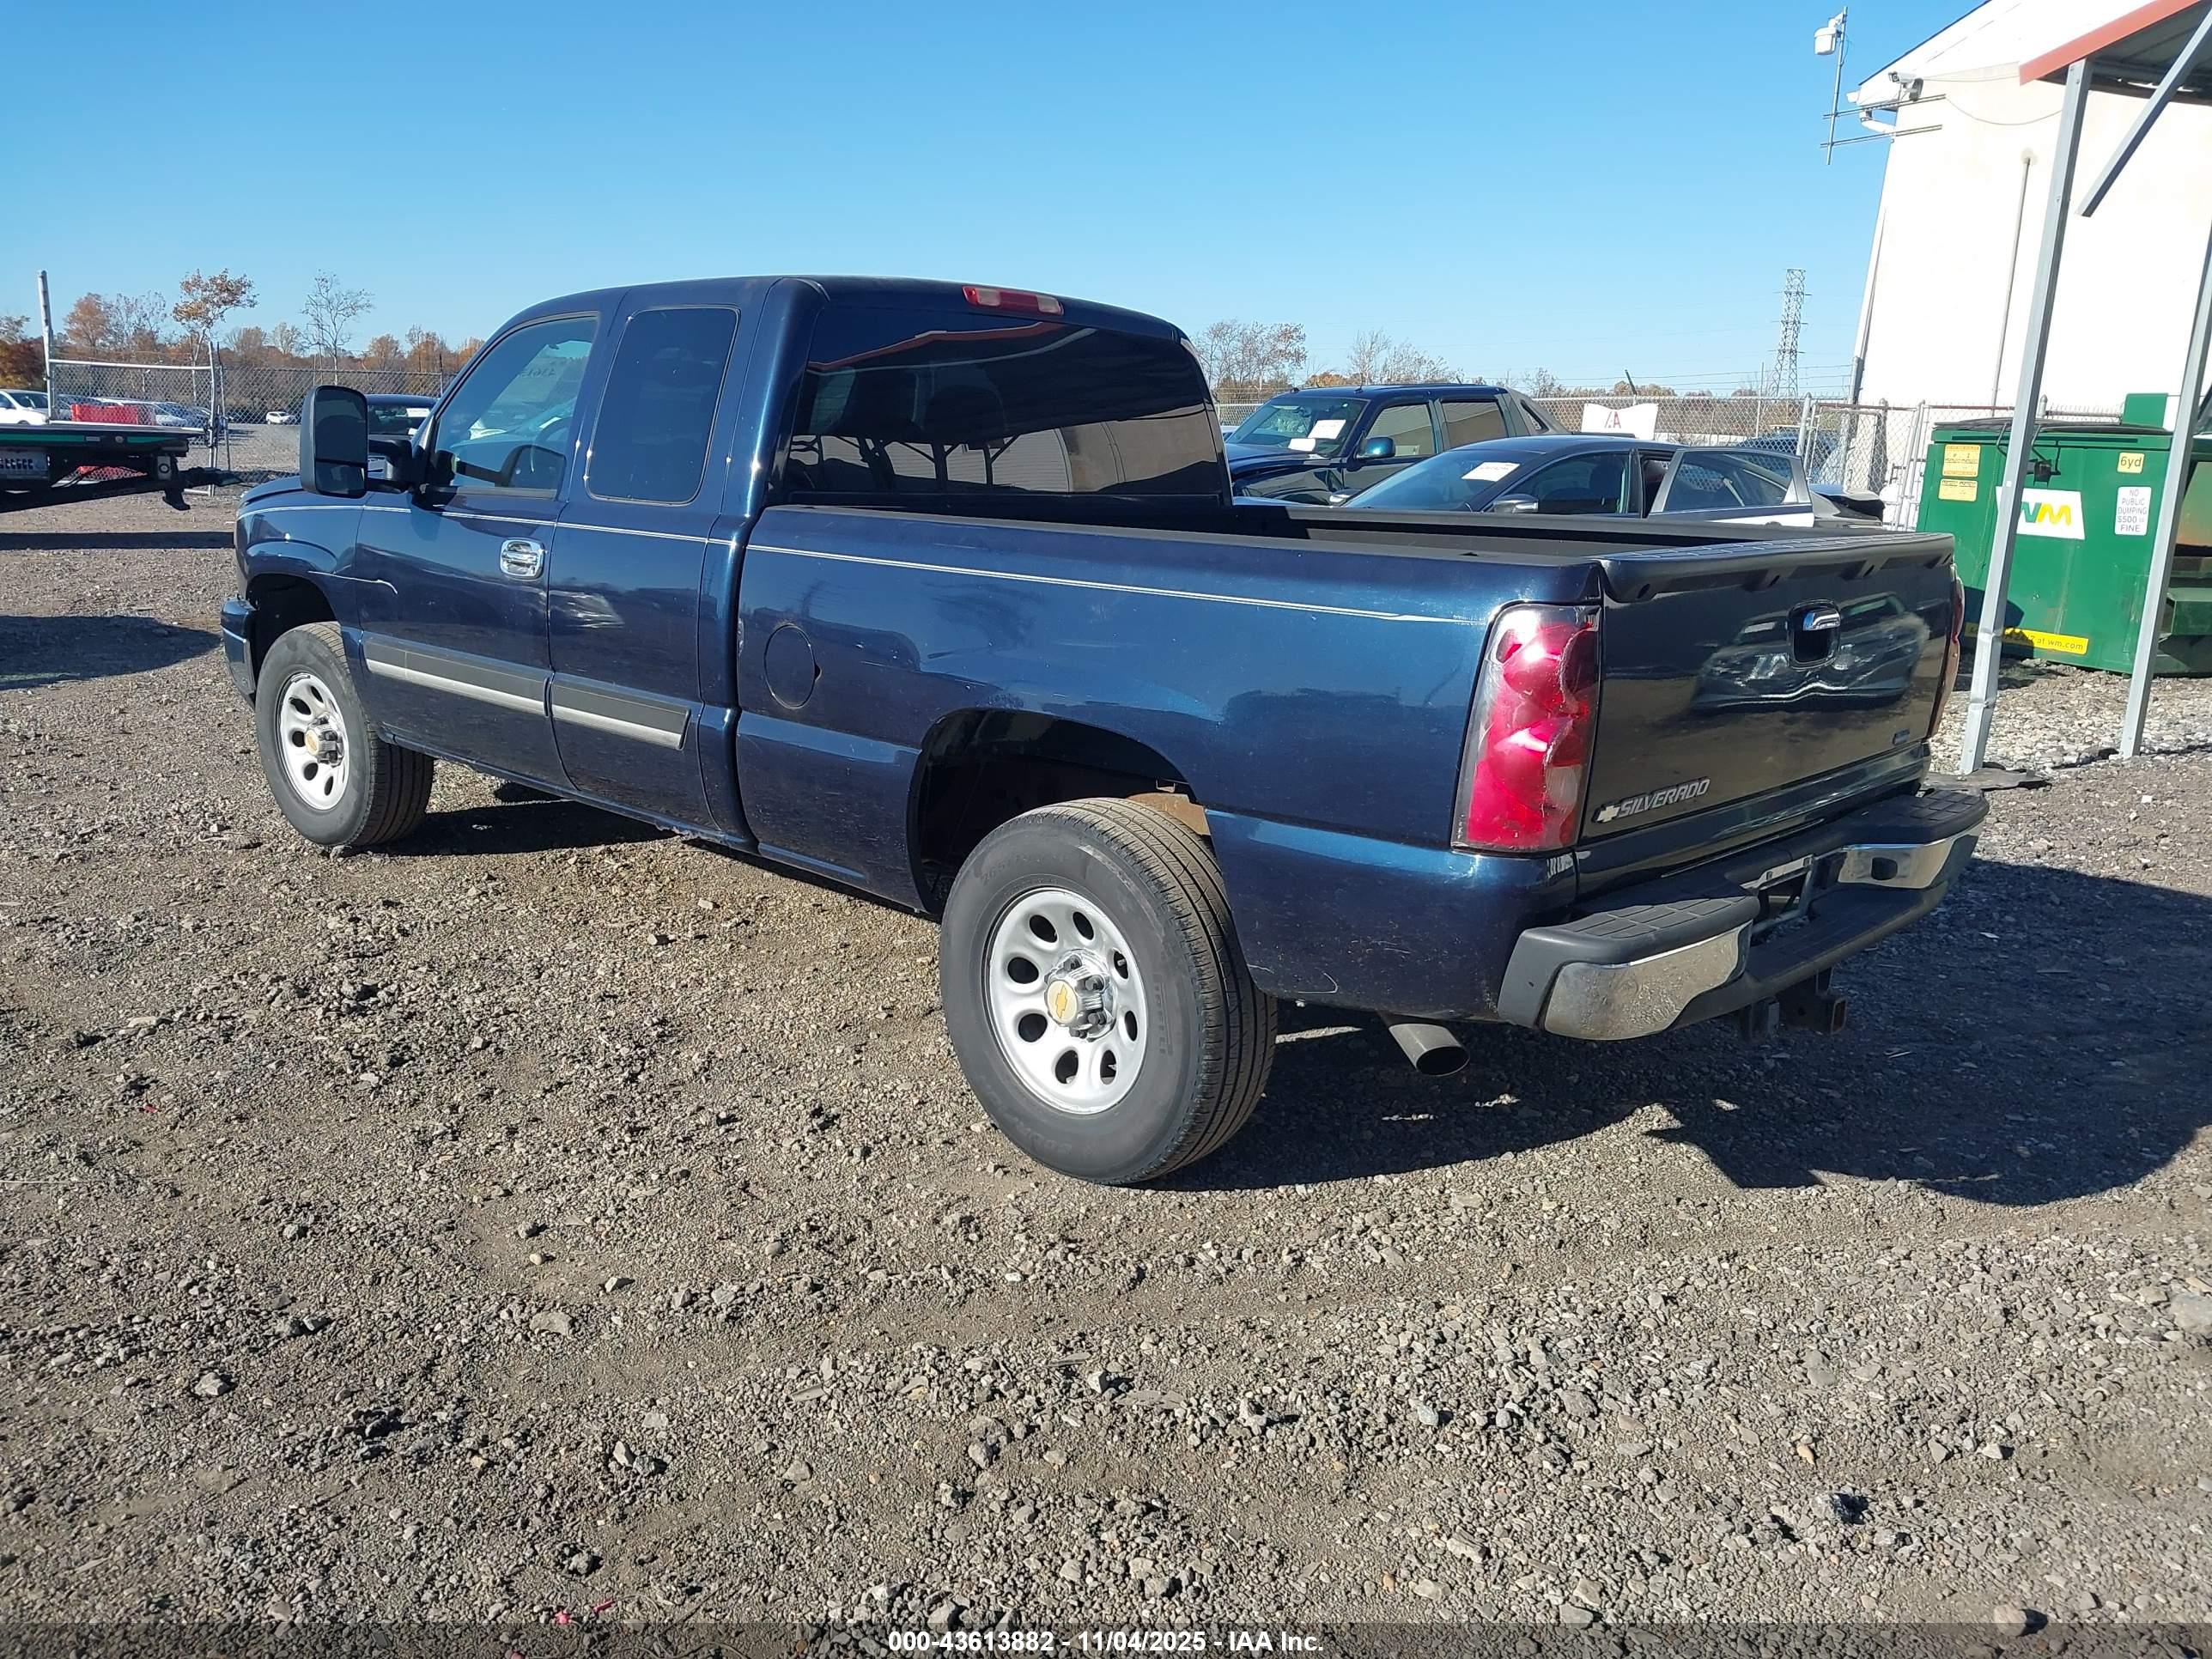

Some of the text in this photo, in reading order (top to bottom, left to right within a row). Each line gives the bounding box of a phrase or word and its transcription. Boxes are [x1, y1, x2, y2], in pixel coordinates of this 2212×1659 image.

[2120, 456, 2142, 469] 6yd
[2129, 489, 2140, 497] NO
[2118, 507, 2148, 515] DUMPING
[2047, 639, 2084, 651] wm.com
[1619, 778, 1711, 818] SILVERADO
